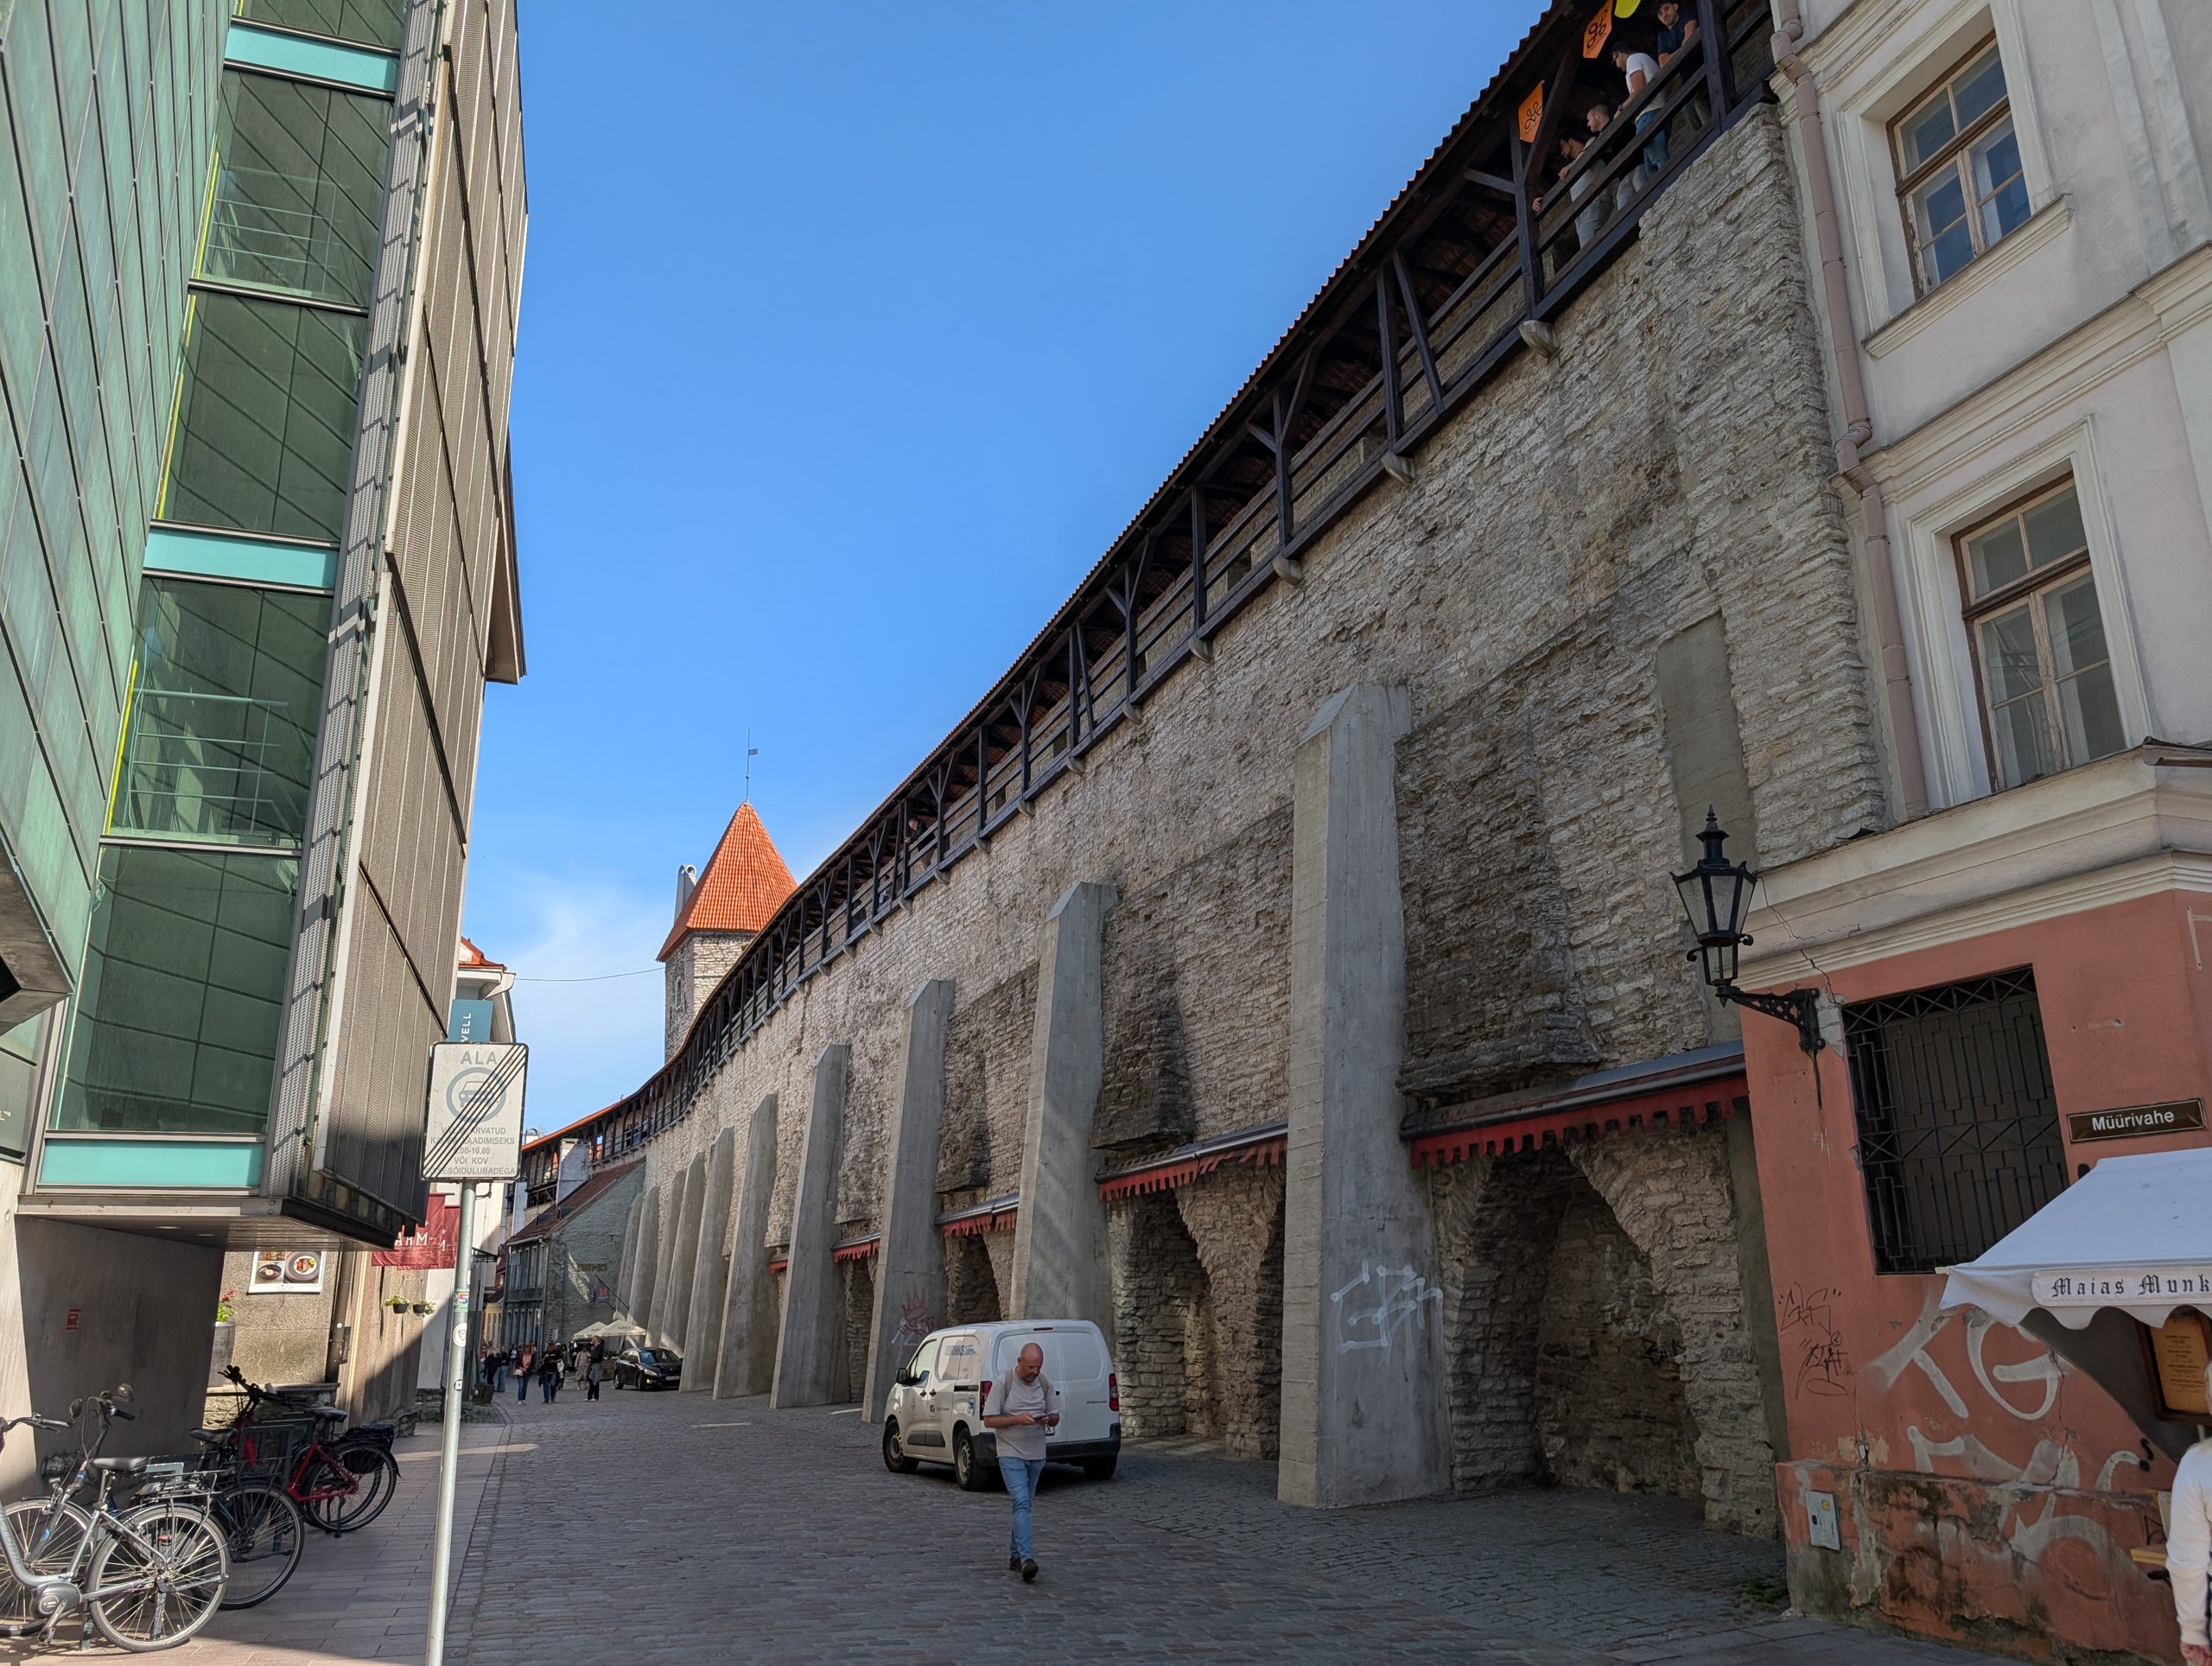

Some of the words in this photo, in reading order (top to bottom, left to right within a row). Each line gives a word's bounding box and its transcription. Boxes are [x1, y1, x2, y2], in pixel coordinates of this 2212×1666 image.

[461, 1051, 498, 1065] ALA
[2091, 1110, 2175, 1131] Müürivahe
[2051, 1277, 2125, 1298] Maias
[2138, 1274, 2211, 1296] Munk
